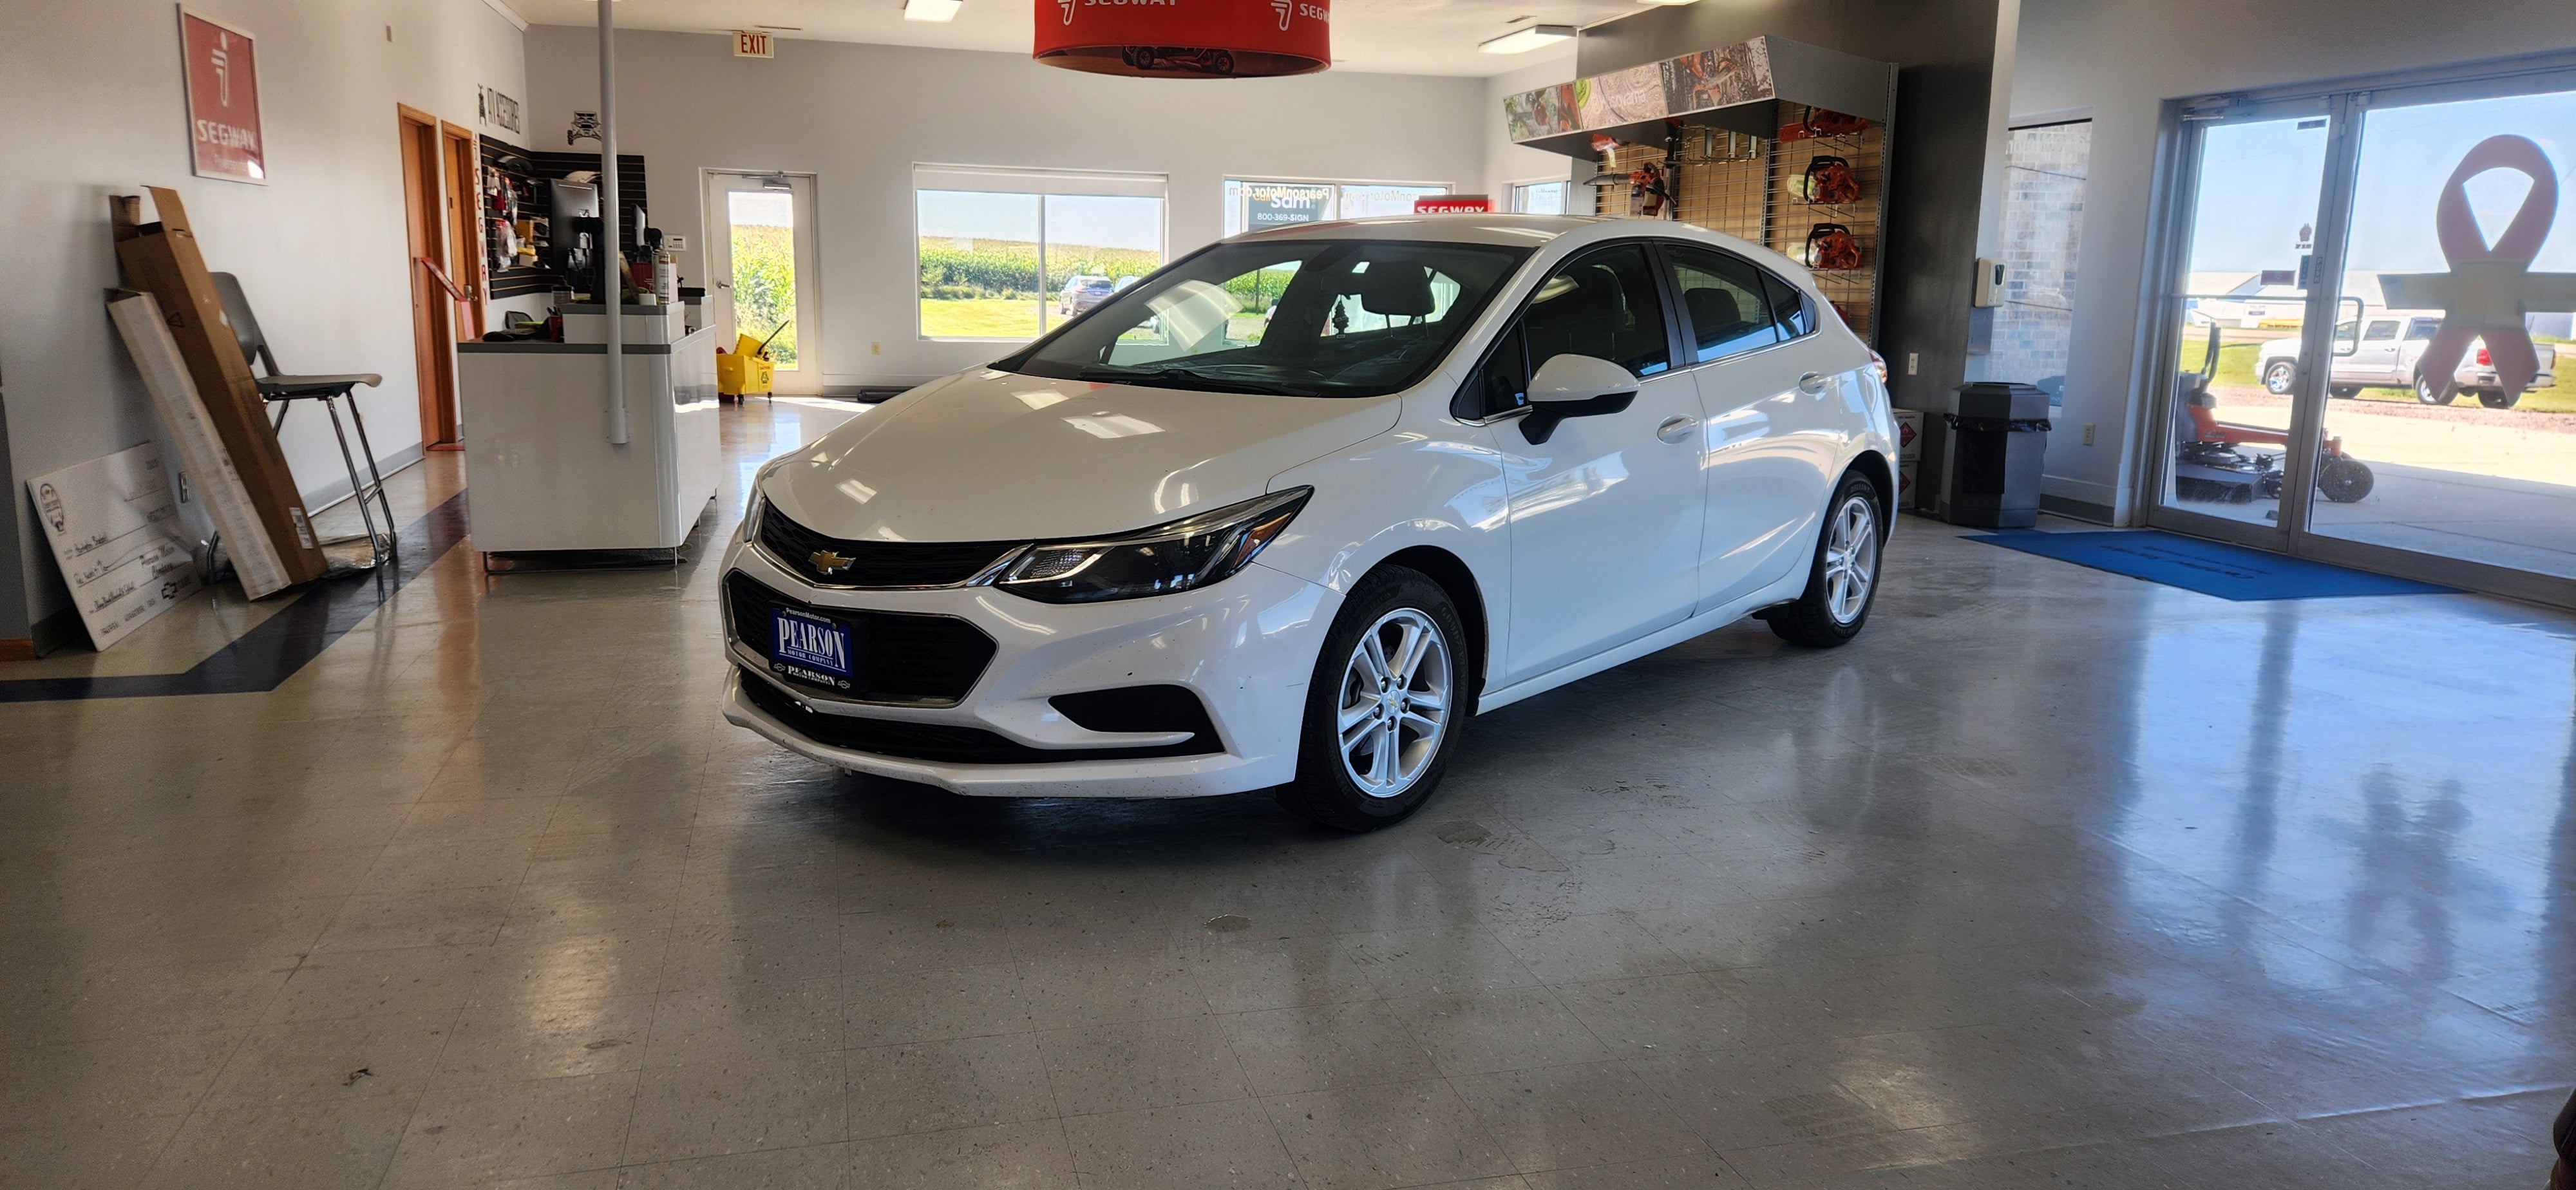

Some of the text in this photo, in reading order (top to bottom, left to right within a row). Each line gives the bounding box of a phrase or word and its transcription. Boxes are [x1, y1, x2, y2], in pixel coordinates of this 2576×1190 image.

[741, 34, 766, 54] EXIT
[197, 119, 256, 150] SEGWAY
[1257, 212, 1309, 222] 800-369-SIGN
[786, 607, 831, 624] PearsonMotor.com
[777, 617, 845, 669] PEARSON
[787, 648, 834, 666] MOTOR COMPANY
[788, 665, 835, 686] PEARSON
